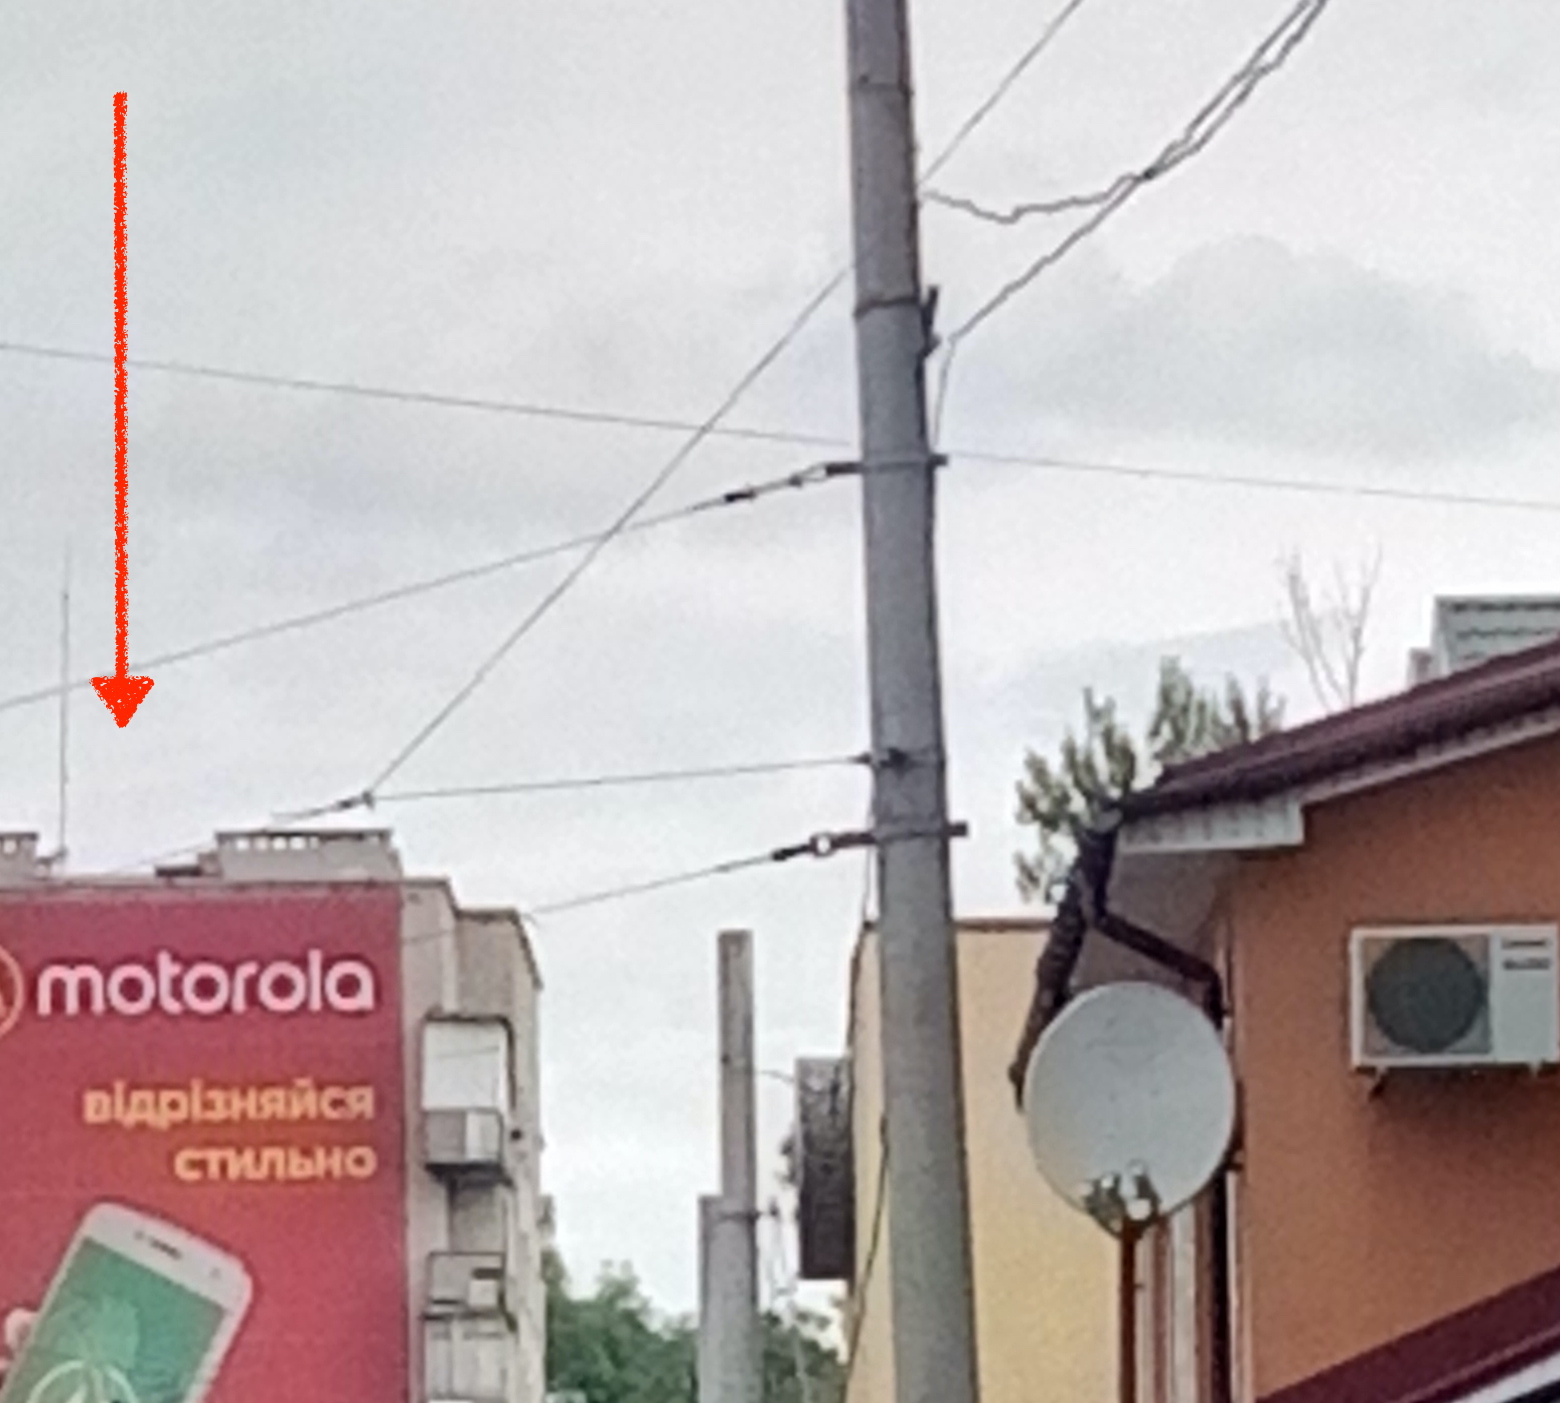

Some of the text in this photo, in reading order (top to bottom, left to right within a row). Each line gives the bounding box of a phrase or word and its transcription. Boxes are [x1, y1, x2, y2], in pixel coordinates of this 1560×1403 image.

[37, 949, 375, 1016] motorola
[81, 1076, 375, 1130] відрізняйся
[172, 1145, 378, 1182] стильно
